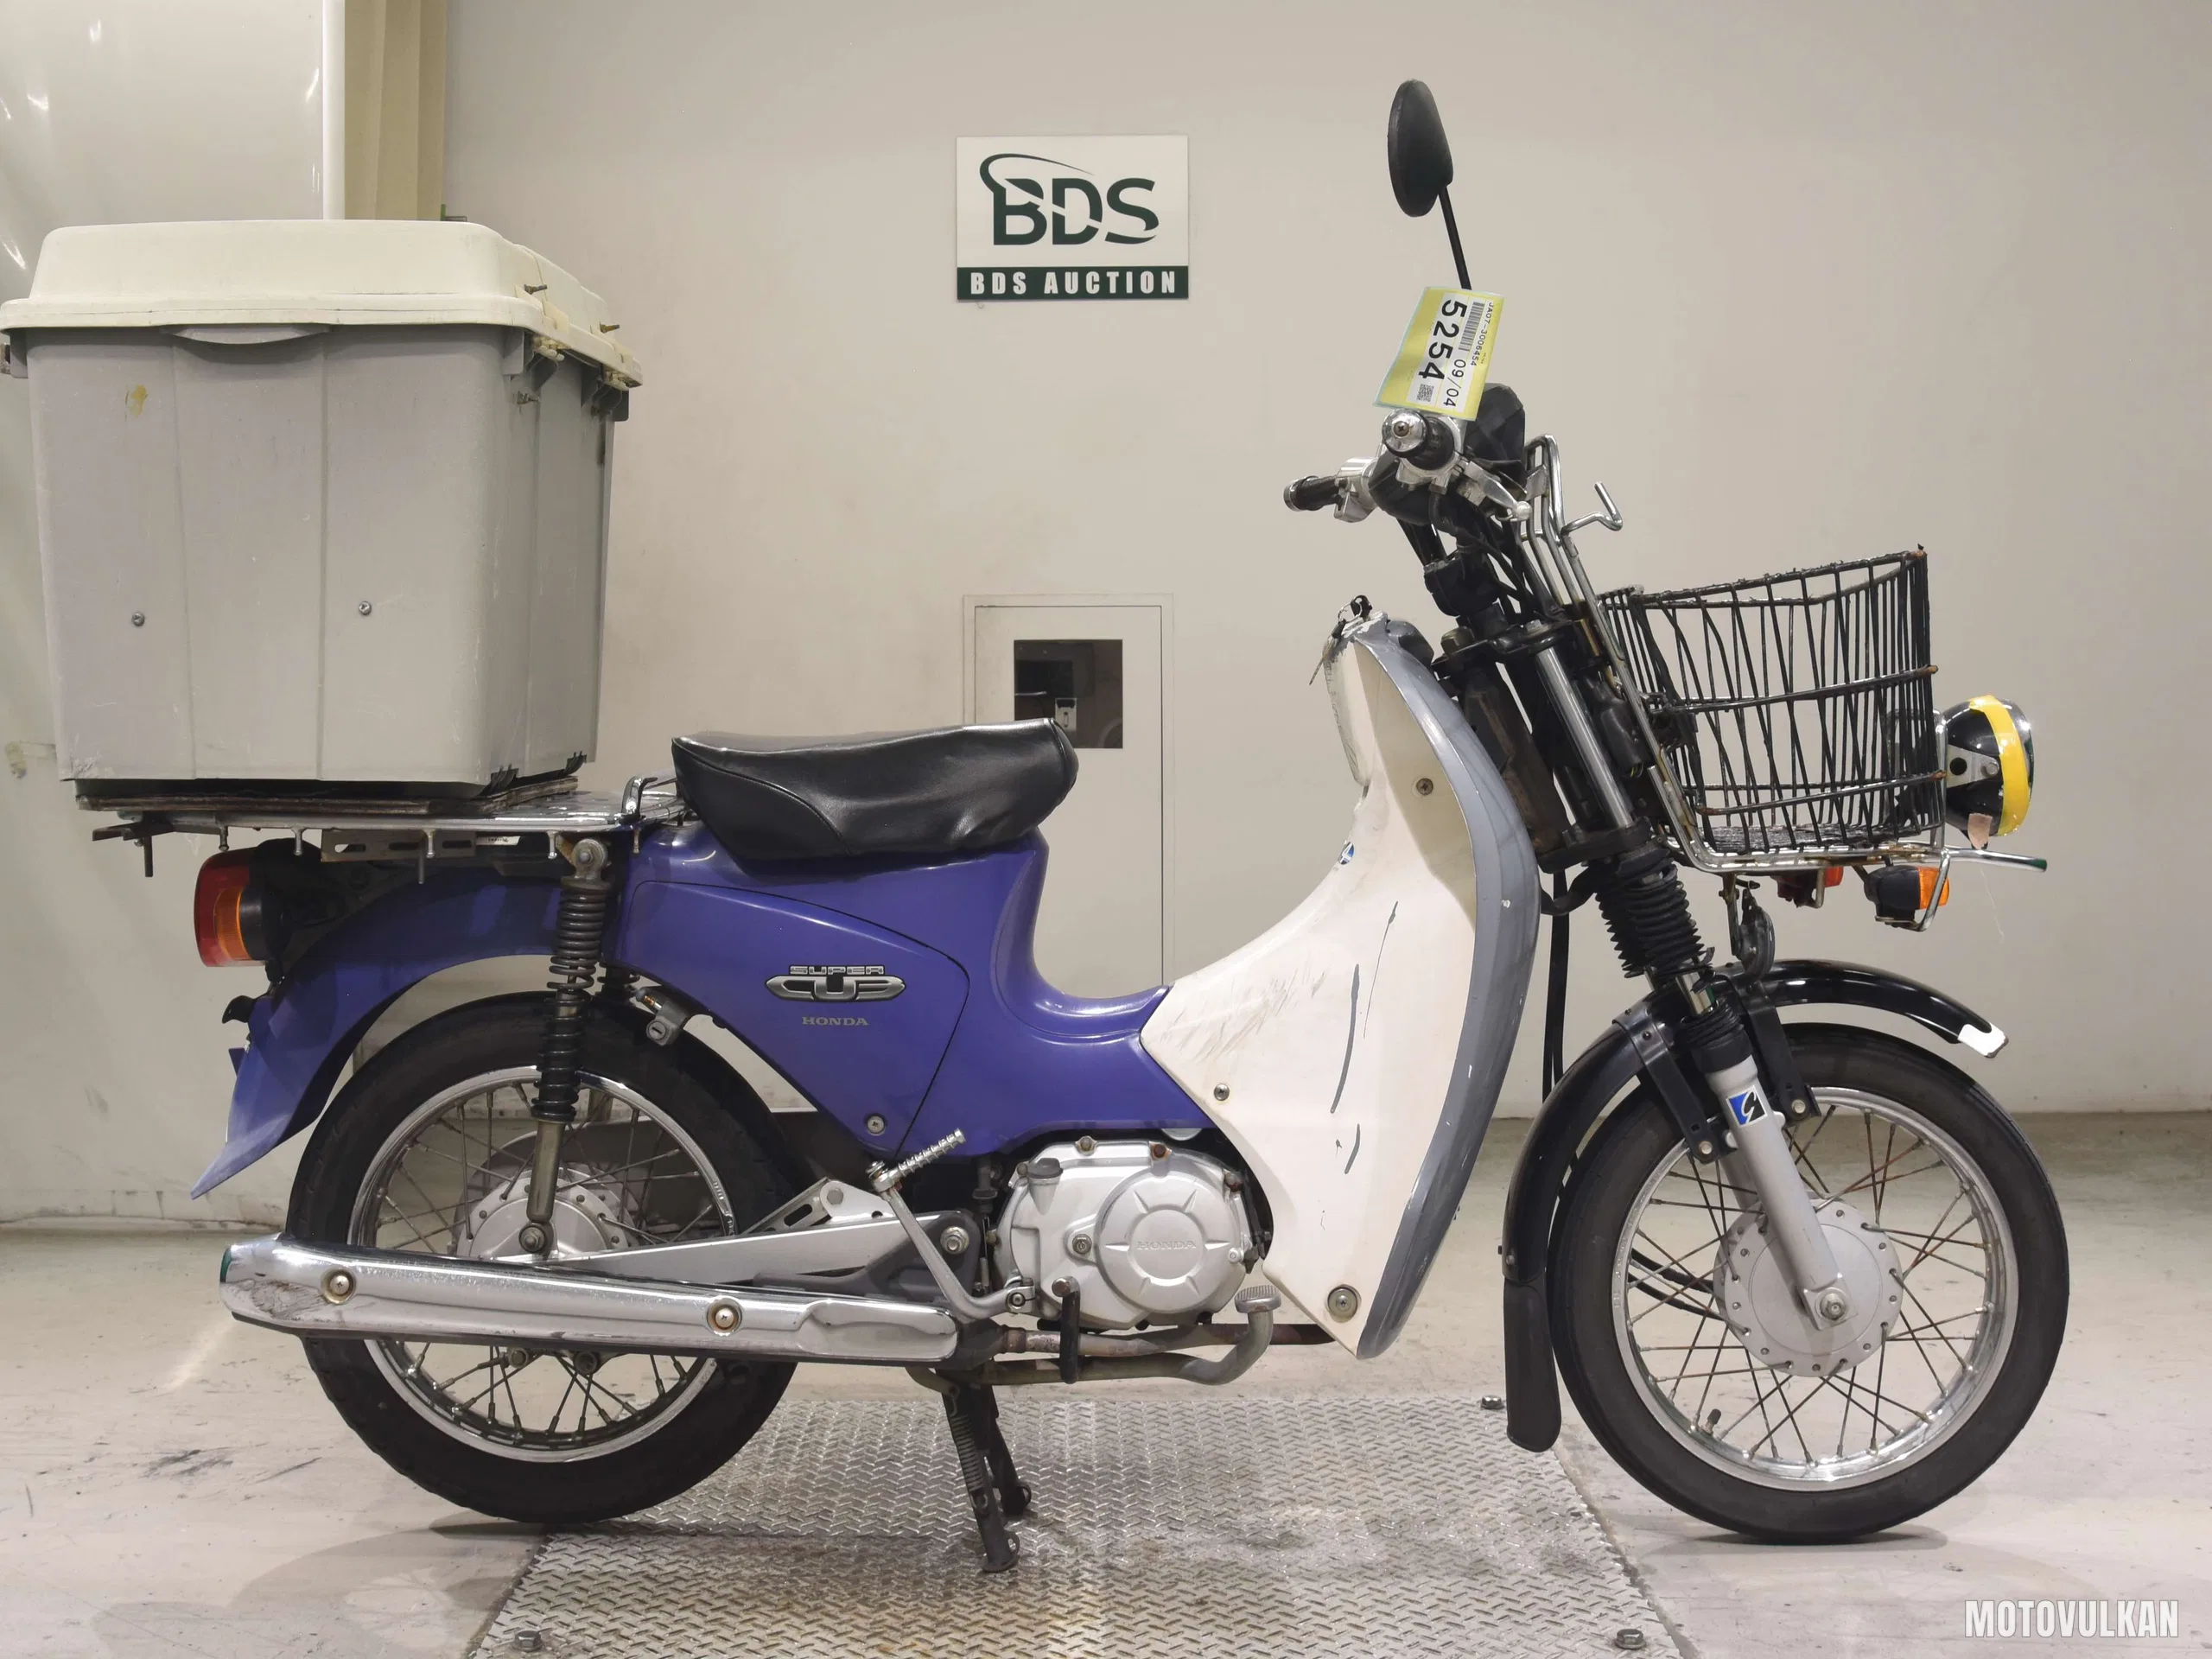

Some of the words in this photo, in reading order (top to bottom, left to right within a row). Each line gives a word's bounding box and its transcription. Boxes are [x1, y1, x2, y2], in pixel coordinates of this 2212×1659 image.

[980, 154, 1160, 245] BDS
[970, 270, 1027, 296] BDS
[1044, 270, 1176, 295] AUCTION
[1418, 299, 1468, 380] 5254
[1442, 359, 1466, 408] 09/04
[790, 965, 884, 976] SUPER
[802, 1016, 869, 1026] HONDA
[1137, 1240, 1197, 1250] HONDA
